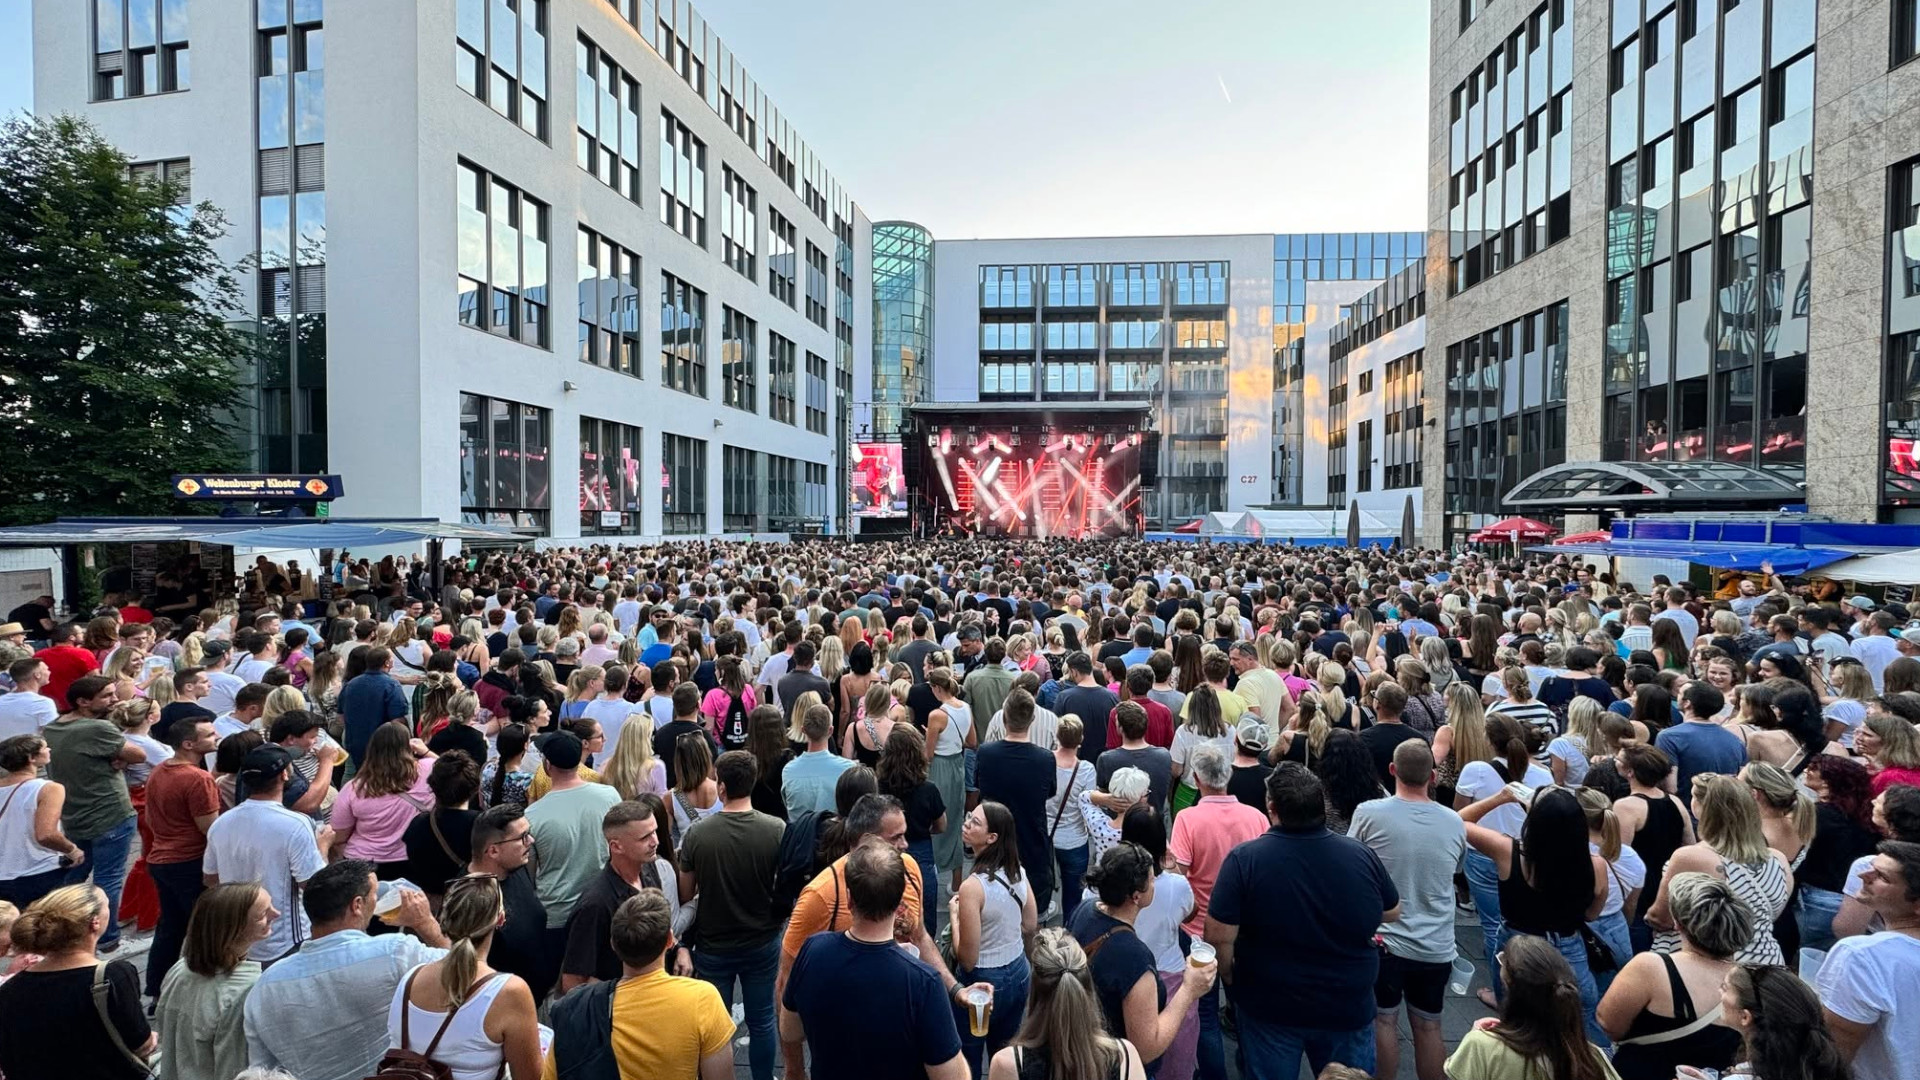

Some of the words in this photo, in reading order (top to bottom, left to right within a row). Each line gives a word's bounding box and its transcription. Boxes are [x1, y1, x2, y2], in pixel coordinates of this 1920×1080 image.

[203, 478, 265, 490] Weltenburger
[266, 478, 301, 488] Kloster
[1240, 475, 1257, 484] C27
